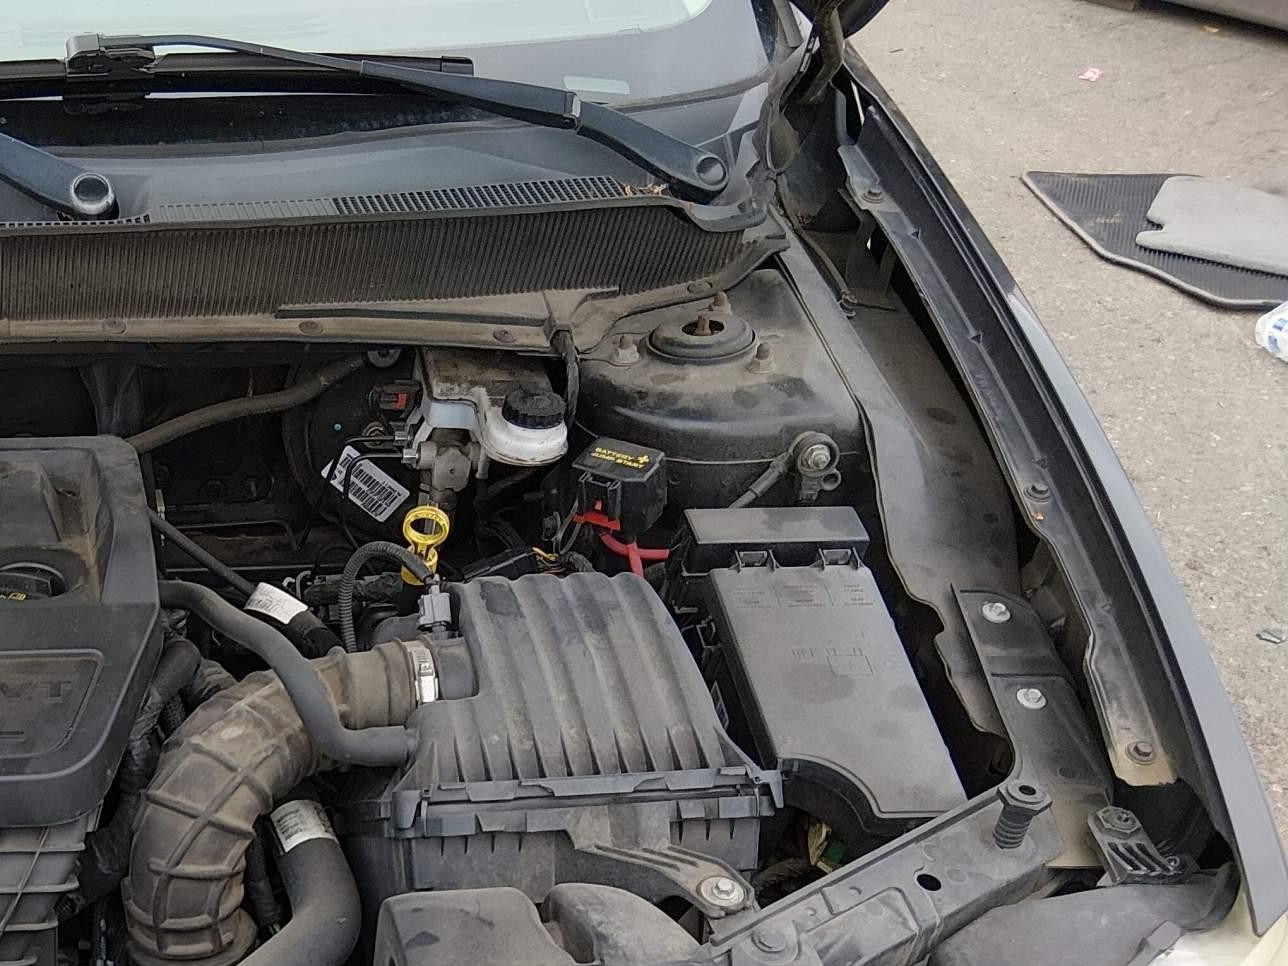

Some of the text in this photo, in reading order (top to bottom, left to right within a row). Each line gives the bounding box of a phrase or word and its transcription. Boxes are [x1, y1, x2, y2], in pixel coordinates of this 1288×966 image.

[590, 452, 645, 469] JUMP START
[595, 447, 635, 461] BATTERY
